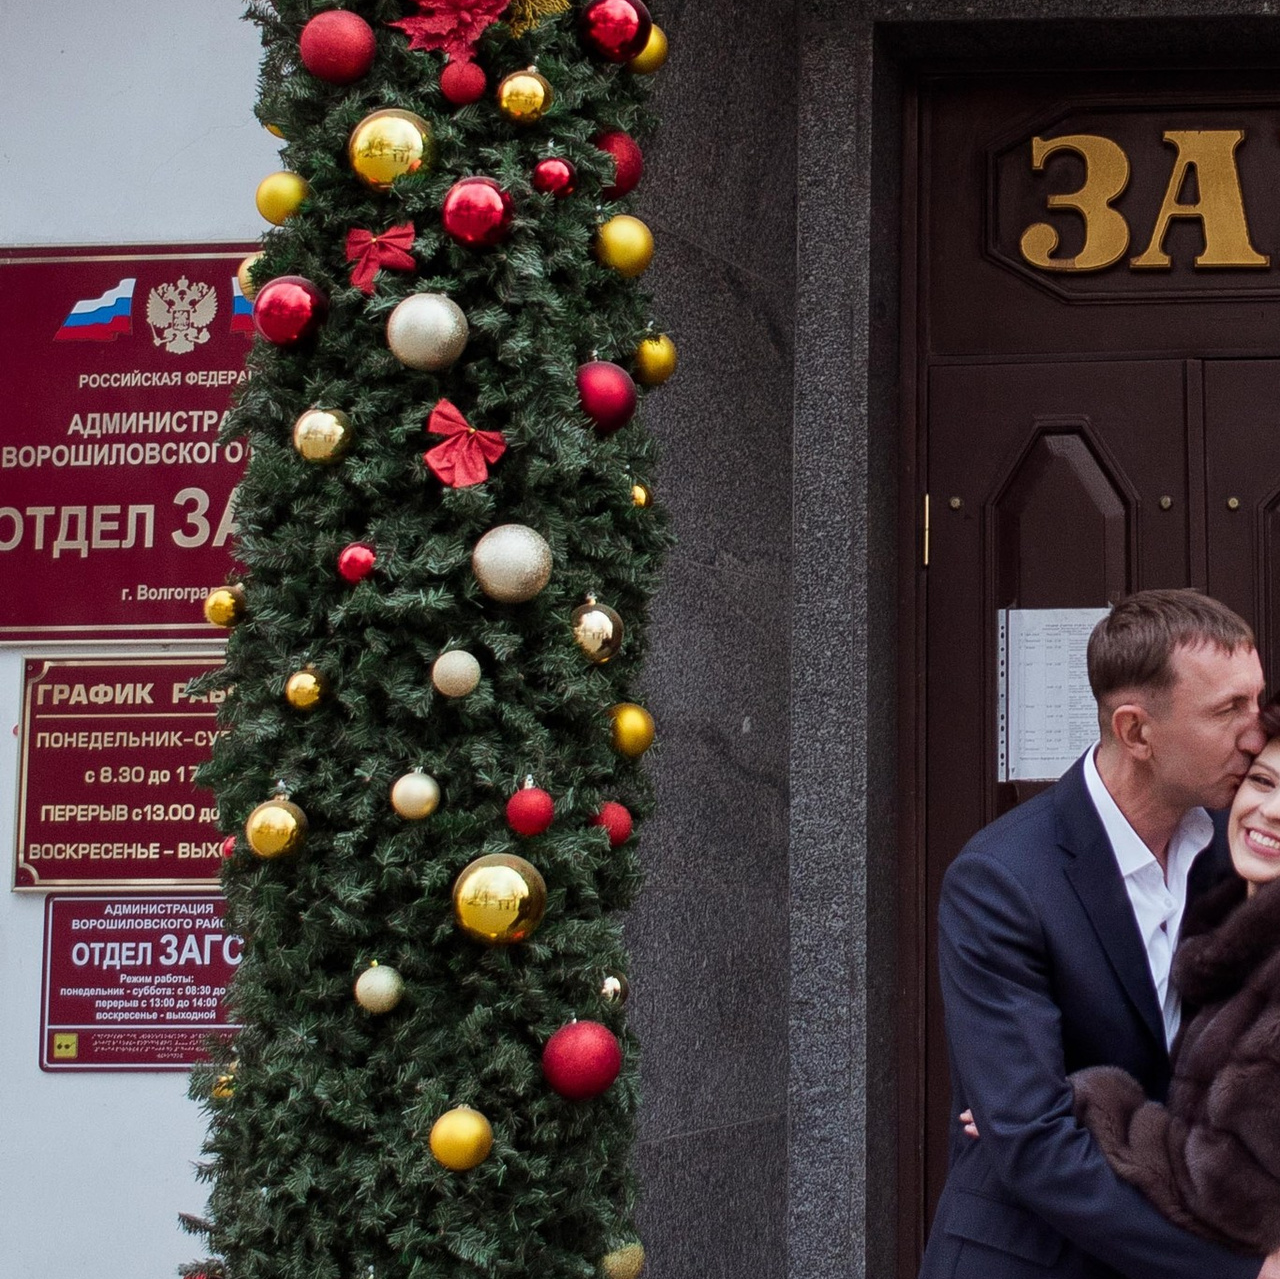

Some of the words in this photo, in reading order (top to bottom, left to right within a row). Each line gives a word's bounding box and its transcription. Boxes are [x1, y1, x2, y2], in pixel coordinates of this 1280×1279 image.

[79, 370, 181, 388] РОССИЙСКАЯ
[185, 370, 252, 388] ФЕДЕРА
[2, 441, 243, 468] ВОРОШИЛОВСКОГО
[0, 504, 155, 559] ОТДЕЛ
[122, 588, 132, 600] г.
[137, 585, 219, 603] Волгогра
[37, 683, 154, 705] ГРАФИК
[85, 769, 95, 783] с
[100, 766, 144, 783] 8.30
[148, 769, 170, 785] до
[41, 804, 128, 822] ПЕРЕРЫВ
[199, 808, 220, 823] до
[29, 842, 160, 860] ВОСКРЕСЕНЬЕ
[104, 903, 214, 916] АДМИНИСТРАЦИЯ
[72, 918, 192, 930] ВОРОШИЛОВСКОГО
[72, 942, 152, 970] ОТДЕЛ
[159, 933, 245, 965] ЗАГС
[120, 974, 152, 984] Режим
[154, 974, 194, 985] работы:
[60, 987, 125, 997] понедельник
[132, 985, 175, 998] суббота:
[177, 987, 183, 995] с
[185, 985, 211, 996] 08:30
[212, 987, 226, 996] до
[95, 999, 139, 1010] перерыв
[141, 999, 147, 1007] с
[150, 997, 175, 1007] 13:00
[176, 999, 190, 1009] до
[192, 997, 217, 1007] 14:00
[95, 1011, 158, 1021] воскресенье
[166, 1010, 216, 1021] выходной
